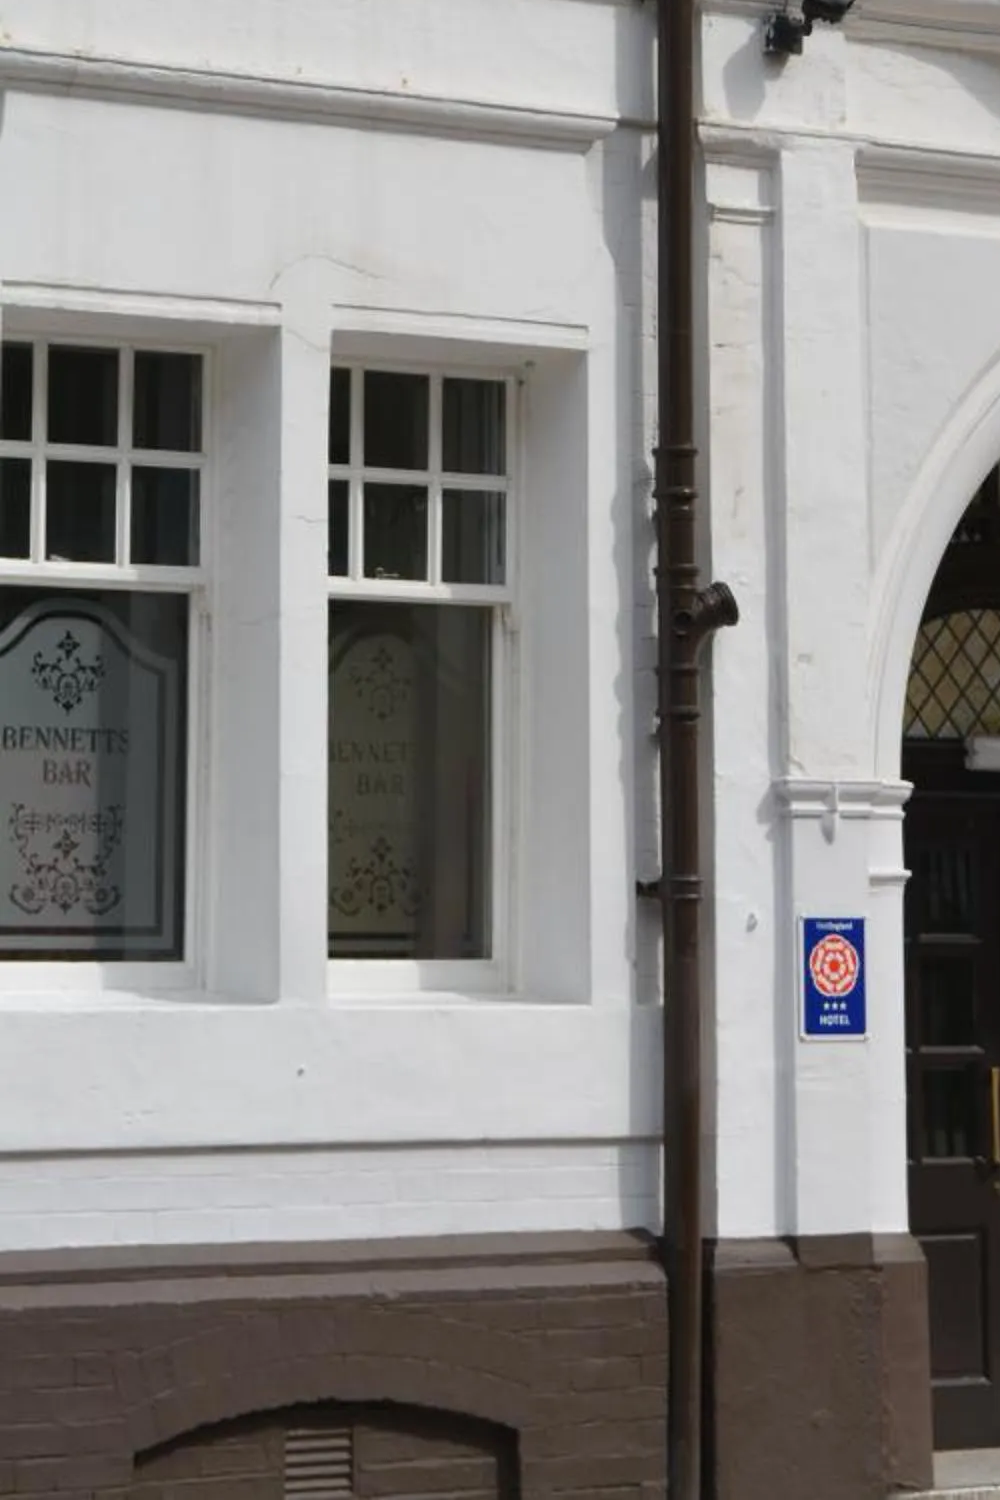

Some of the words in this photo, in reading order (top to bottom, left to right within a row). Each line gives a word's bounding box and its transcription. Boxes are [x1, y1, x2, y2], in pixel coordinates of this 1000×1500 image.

[2, 725, 129, 754] BENNETTS
[42, 759, 92, 788] BAR
[356, 772, 405, 796] BAR
